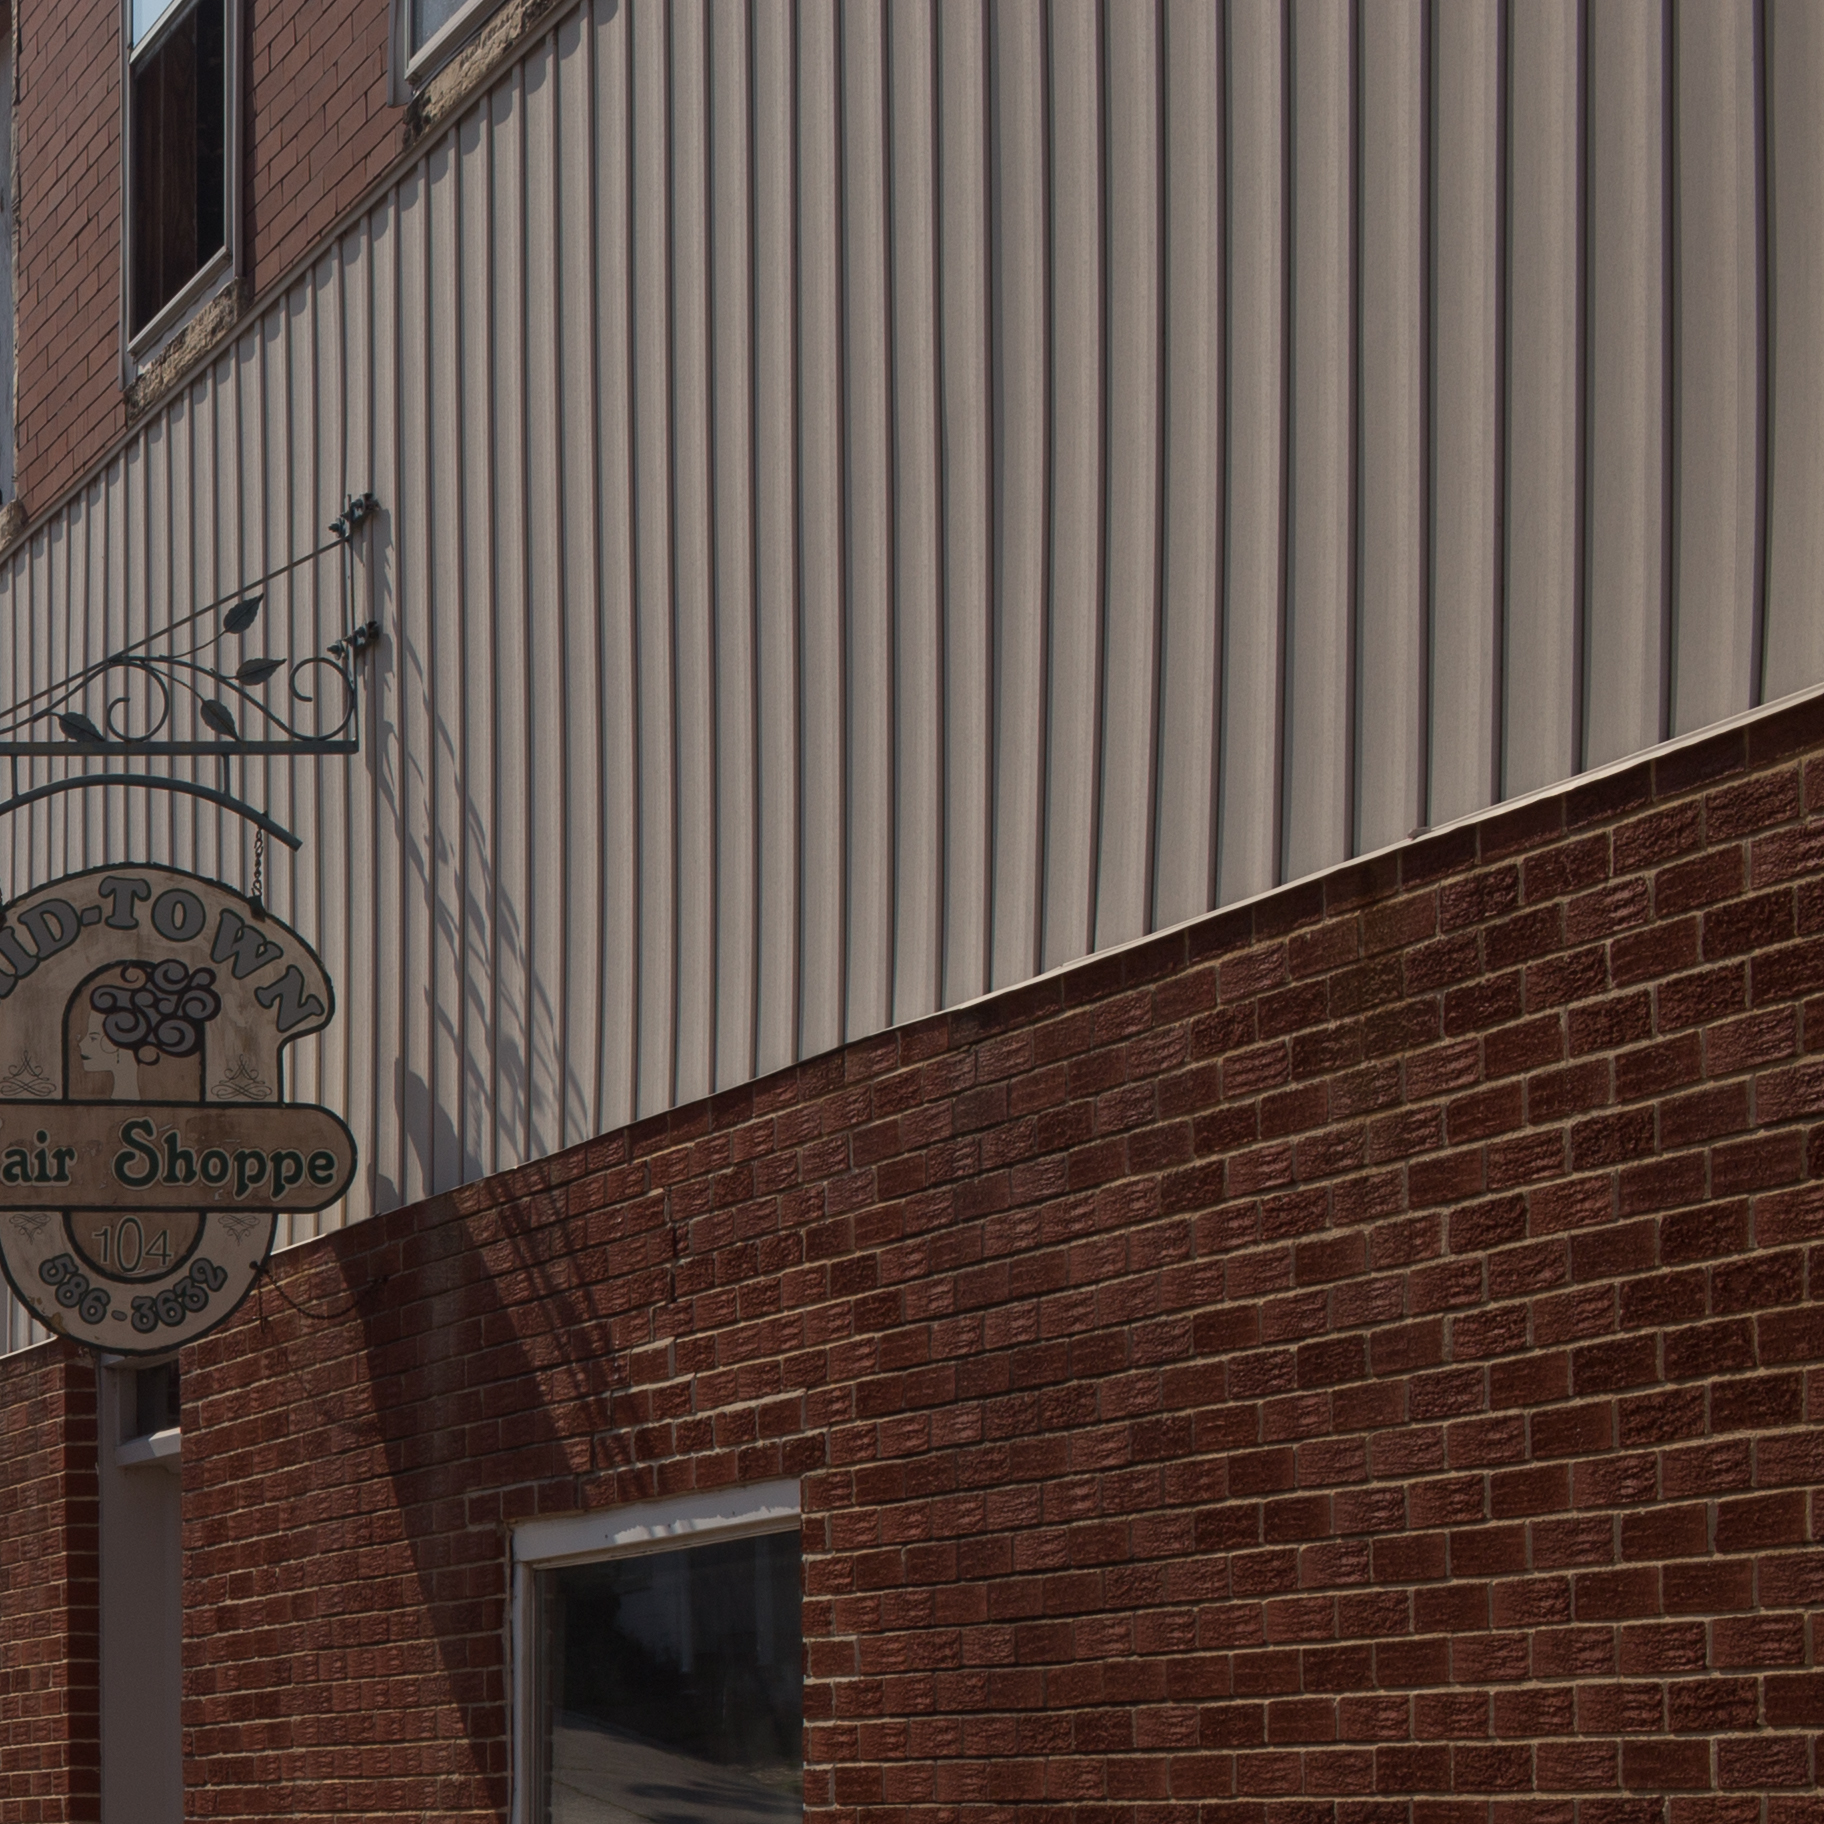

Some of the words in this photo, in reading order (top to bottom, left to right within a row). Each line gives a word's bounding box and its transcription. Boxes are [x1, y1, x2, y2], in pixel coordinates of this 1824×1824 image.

[111, 1116, 338, 1200] Shoppe
[92, 1215, 174, 1273] 104
[38, 1253, 228, 1334] 586-3632
